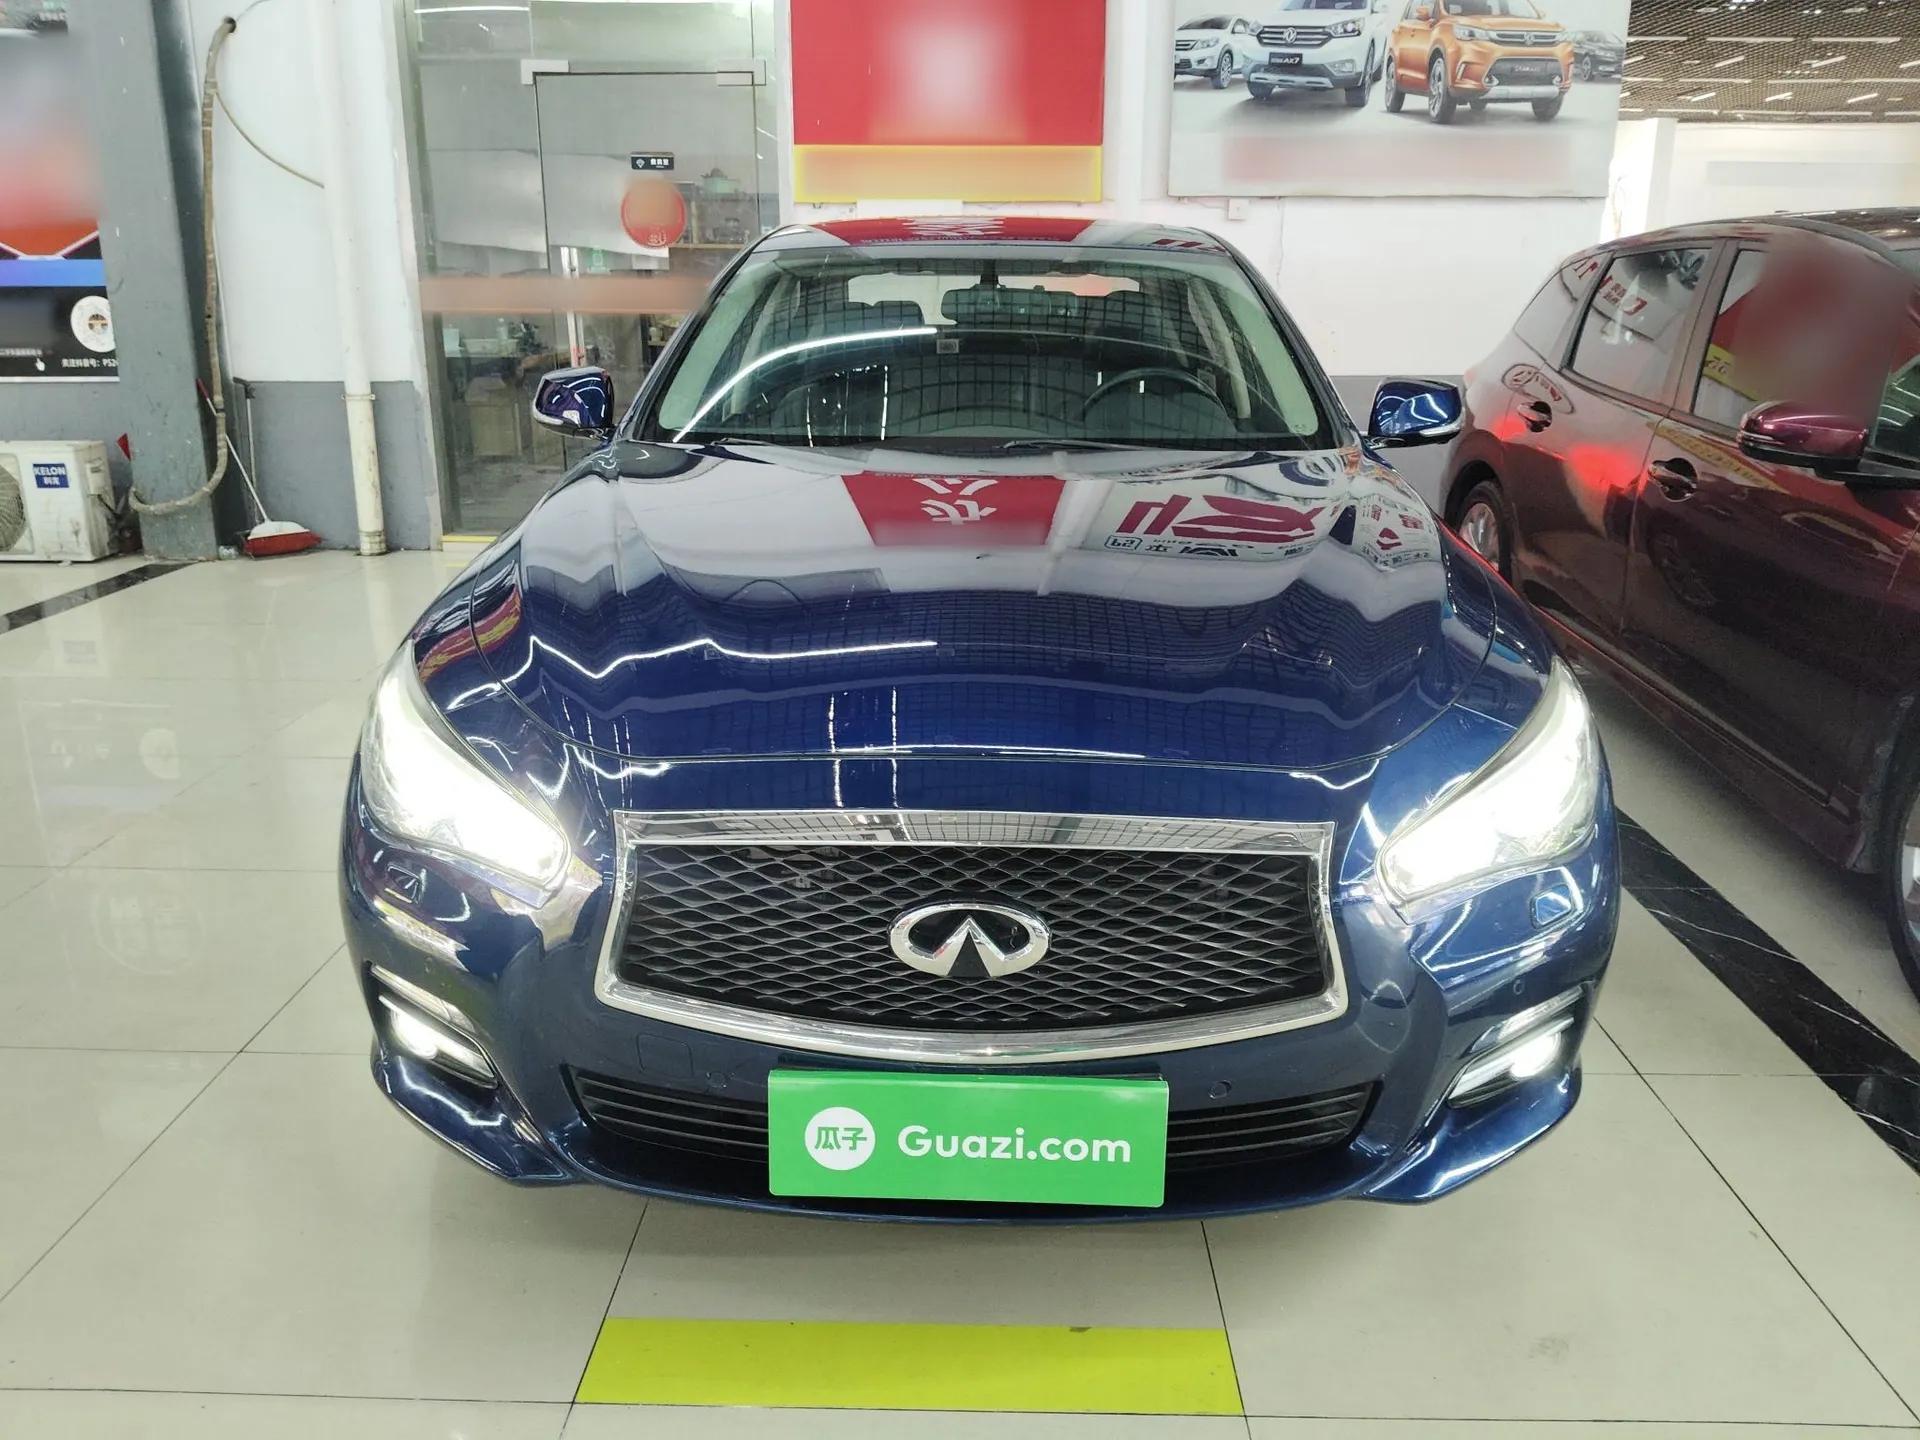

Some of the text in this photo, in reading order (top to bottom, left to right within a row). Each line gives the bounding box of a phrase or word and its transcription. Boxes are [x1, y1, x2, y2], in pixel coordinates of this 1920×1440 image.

[34, 466, 66, 476] KELON
[815, 1126, 867, 1151] 瓜子
[897, 1125, 1131, 1163] Guazi.com
